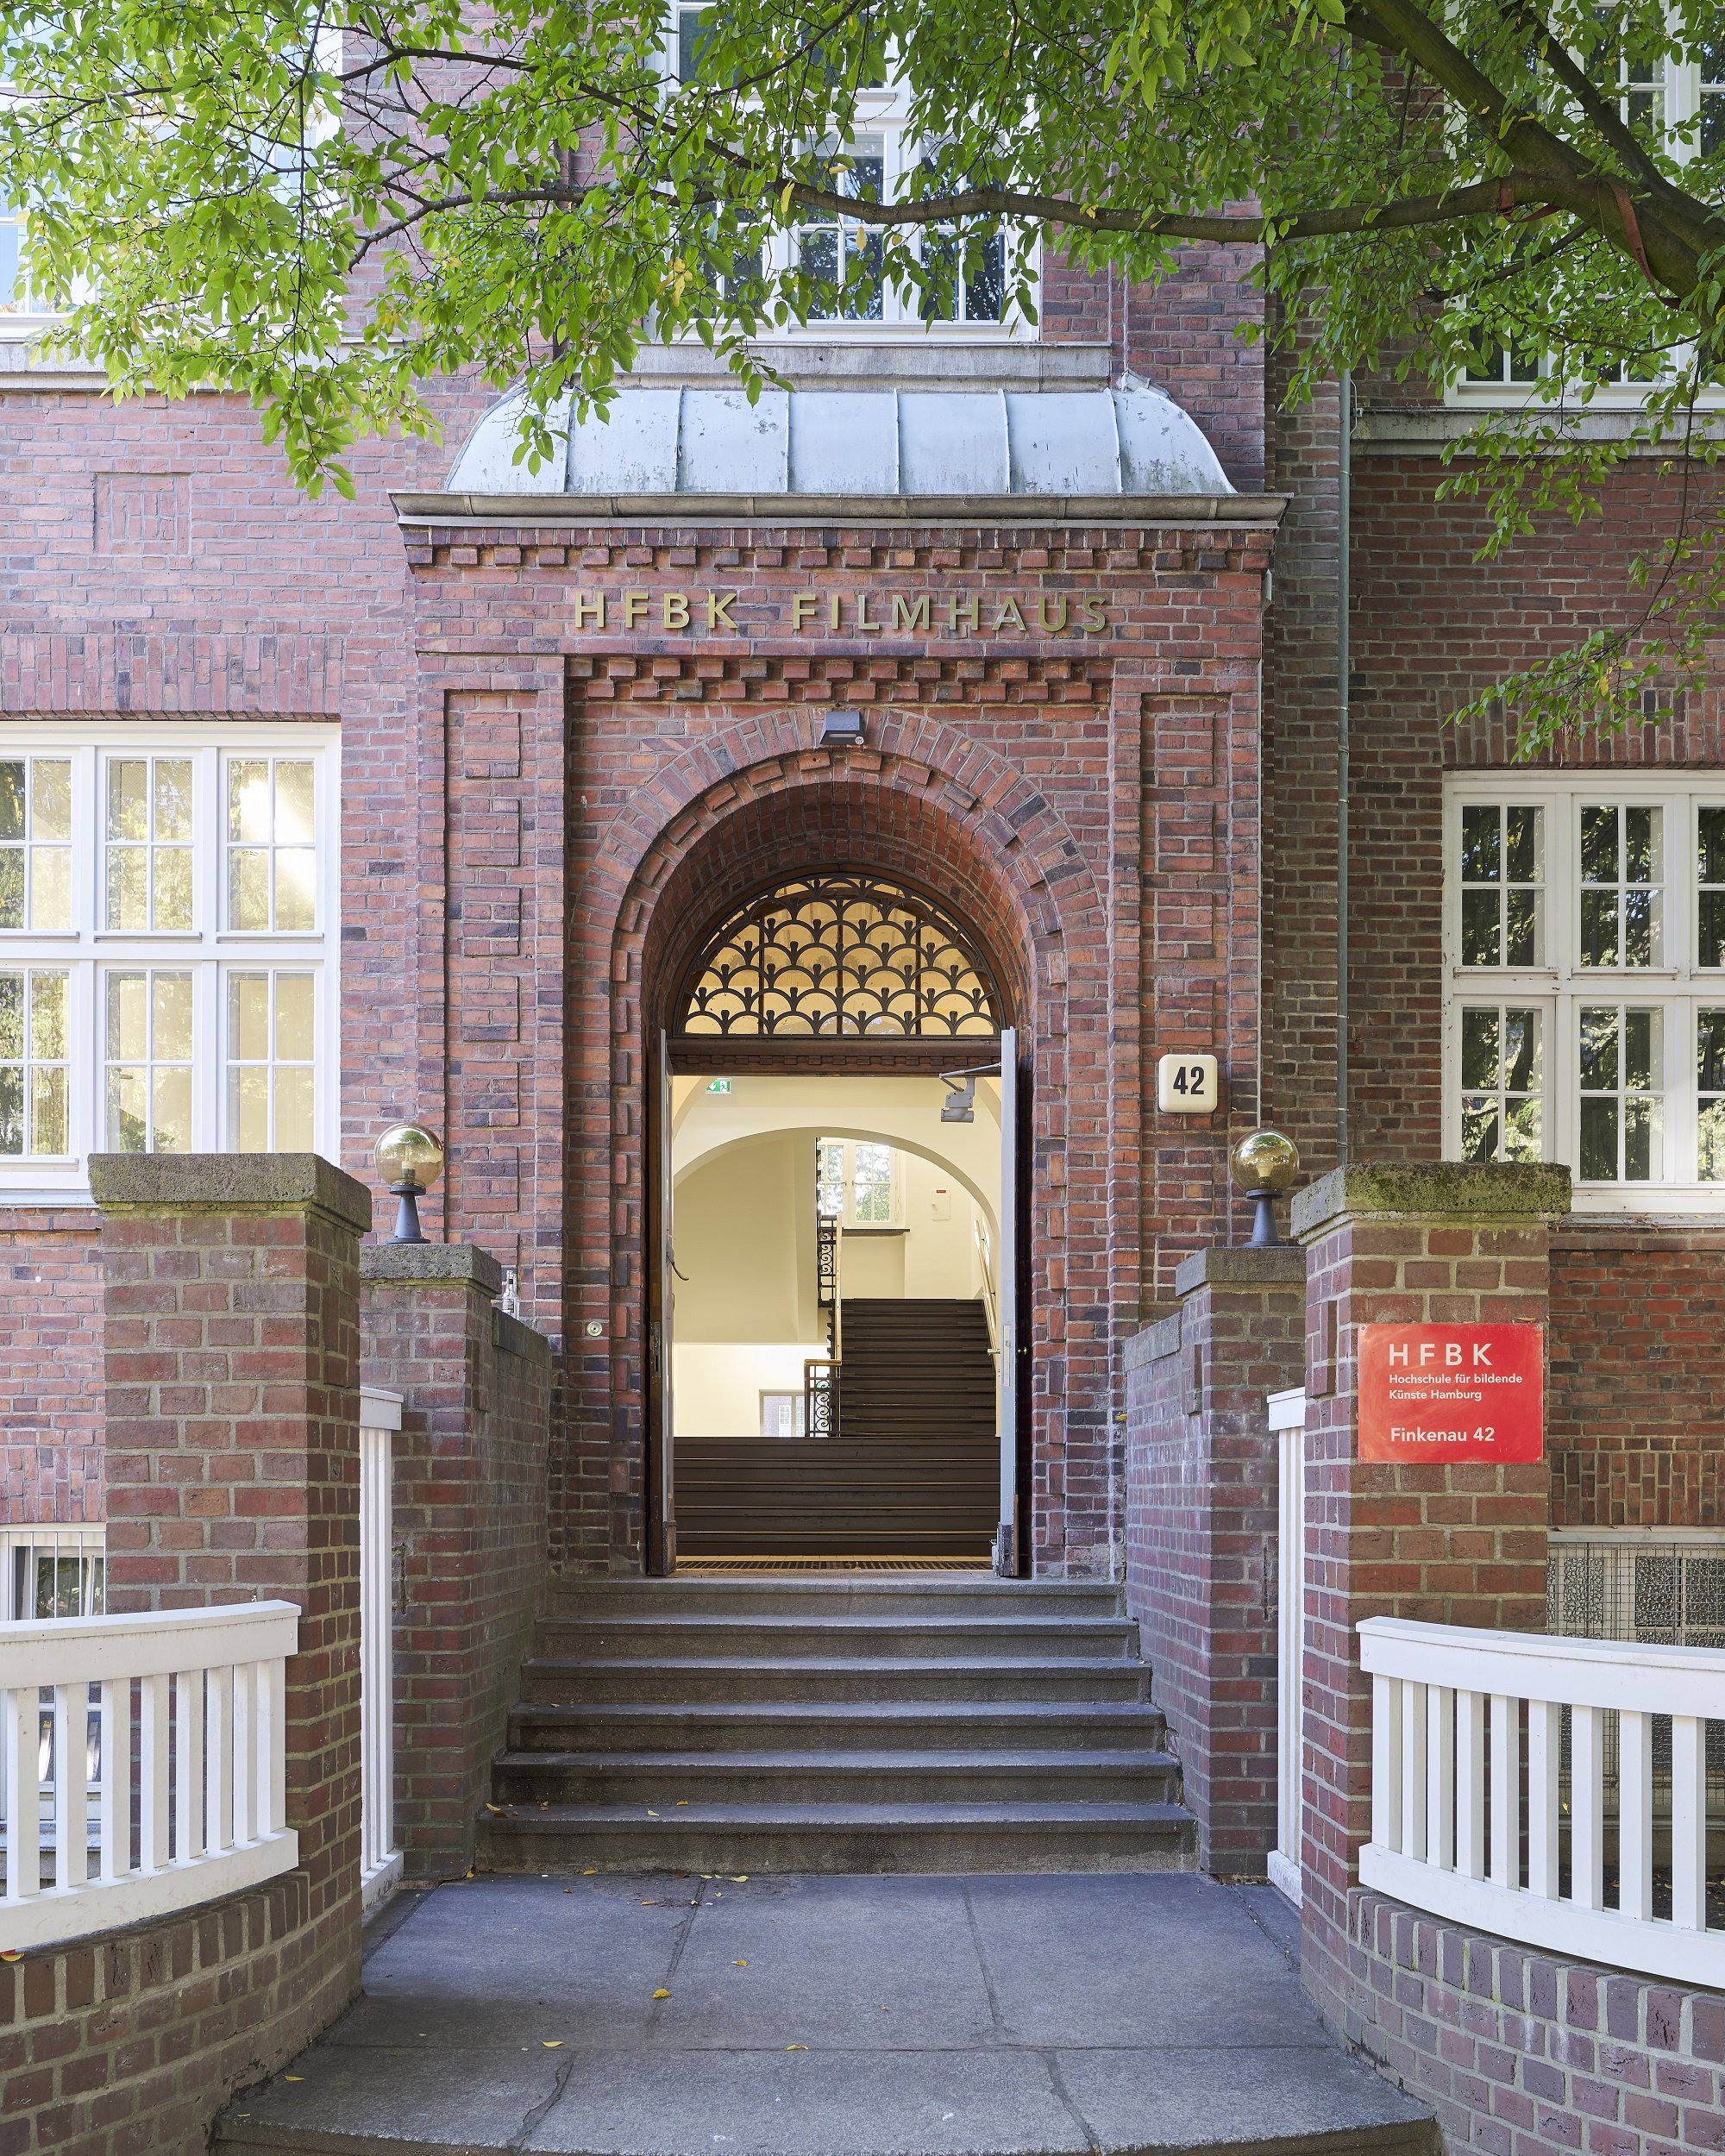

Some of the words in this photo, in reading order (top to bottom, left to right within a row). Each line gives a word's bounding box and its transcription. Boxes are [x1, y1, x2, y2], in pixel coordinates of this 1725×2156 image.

[574, 592, 739, 630] HFBK
[793, 593, 1107, 632] FILMHAUS
[1173, 1066, 1205, 1095] 42
[1389, 1344, 1493, 1366] HFBK
[1389, 1374, 1452, 1384] Hochschule
[1455, 1374, 1471, 1383] für
[1474, 1373, 1522, 1383] bildende
[1389, 1390, 1427, 1400] Künste
[1431, 1389, 1482, 1401] Hamburg
[1390, 1427, 1467, 1442] Finkenau
[1473, 1427, 1495, 1442] 42
